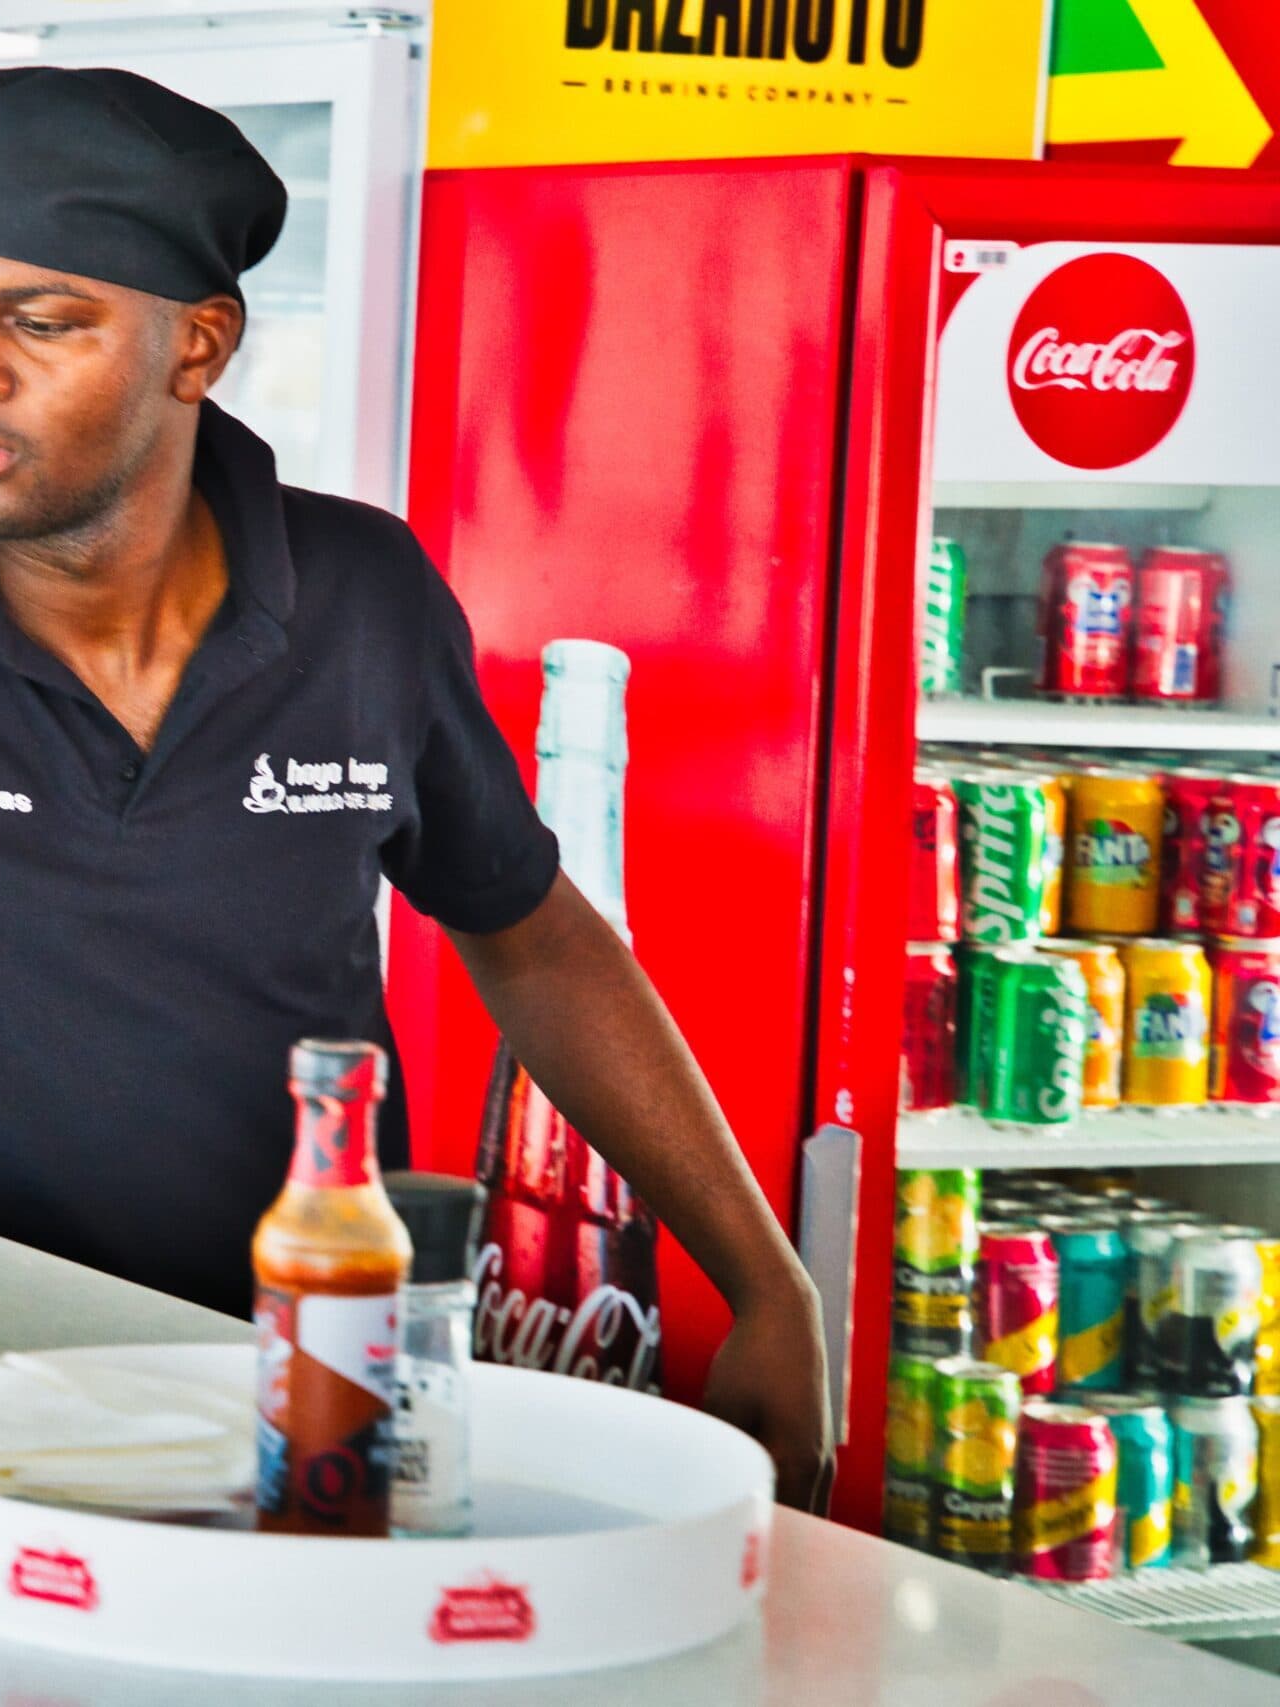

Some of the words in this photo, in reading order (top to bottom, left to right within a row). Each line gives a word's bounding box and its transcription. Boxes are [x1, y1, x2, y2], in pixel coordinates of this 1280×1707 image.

[604, 78, 728, 99] BREWING
[747, 86, 872, 105] COMPANY
[1013, 327, 1184, 391] Coca-Cola
